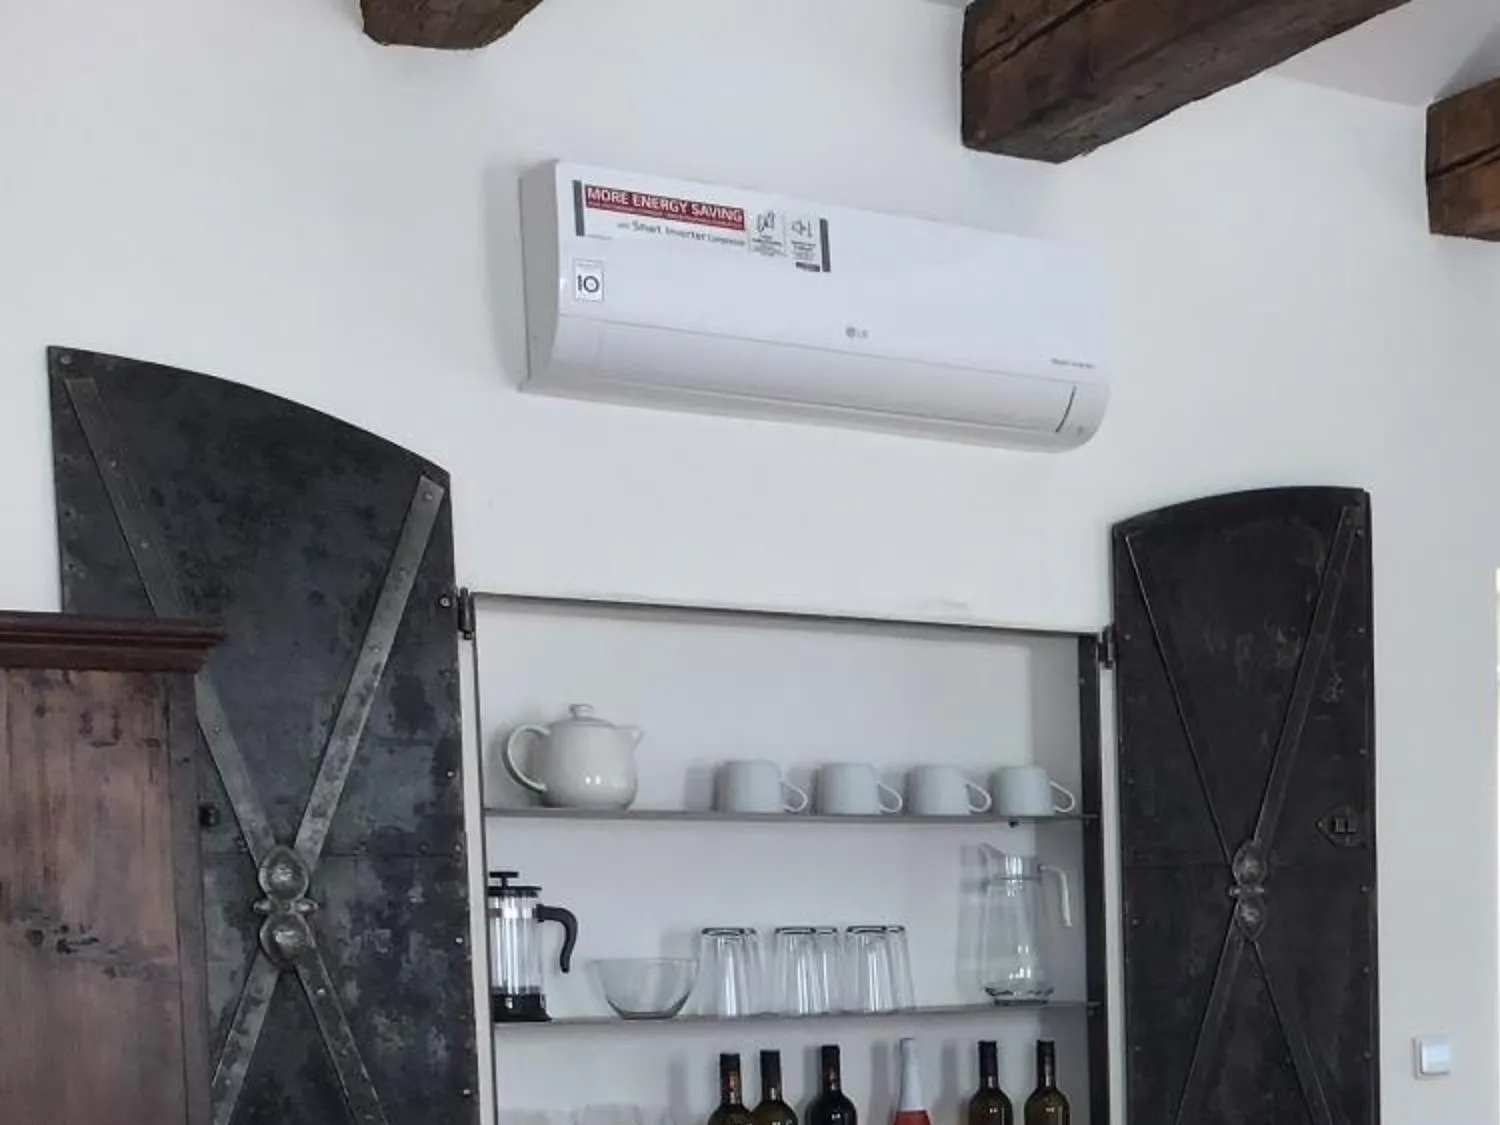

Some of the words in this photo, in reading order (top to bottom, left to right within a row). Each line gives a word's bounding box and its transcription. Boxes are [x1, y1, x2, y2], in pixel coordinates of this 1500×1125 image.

[587, 187, 629, 205] MORE
[632, 194, 688, 214] ENERGY
[691, 203, 743, 222] SAVING
